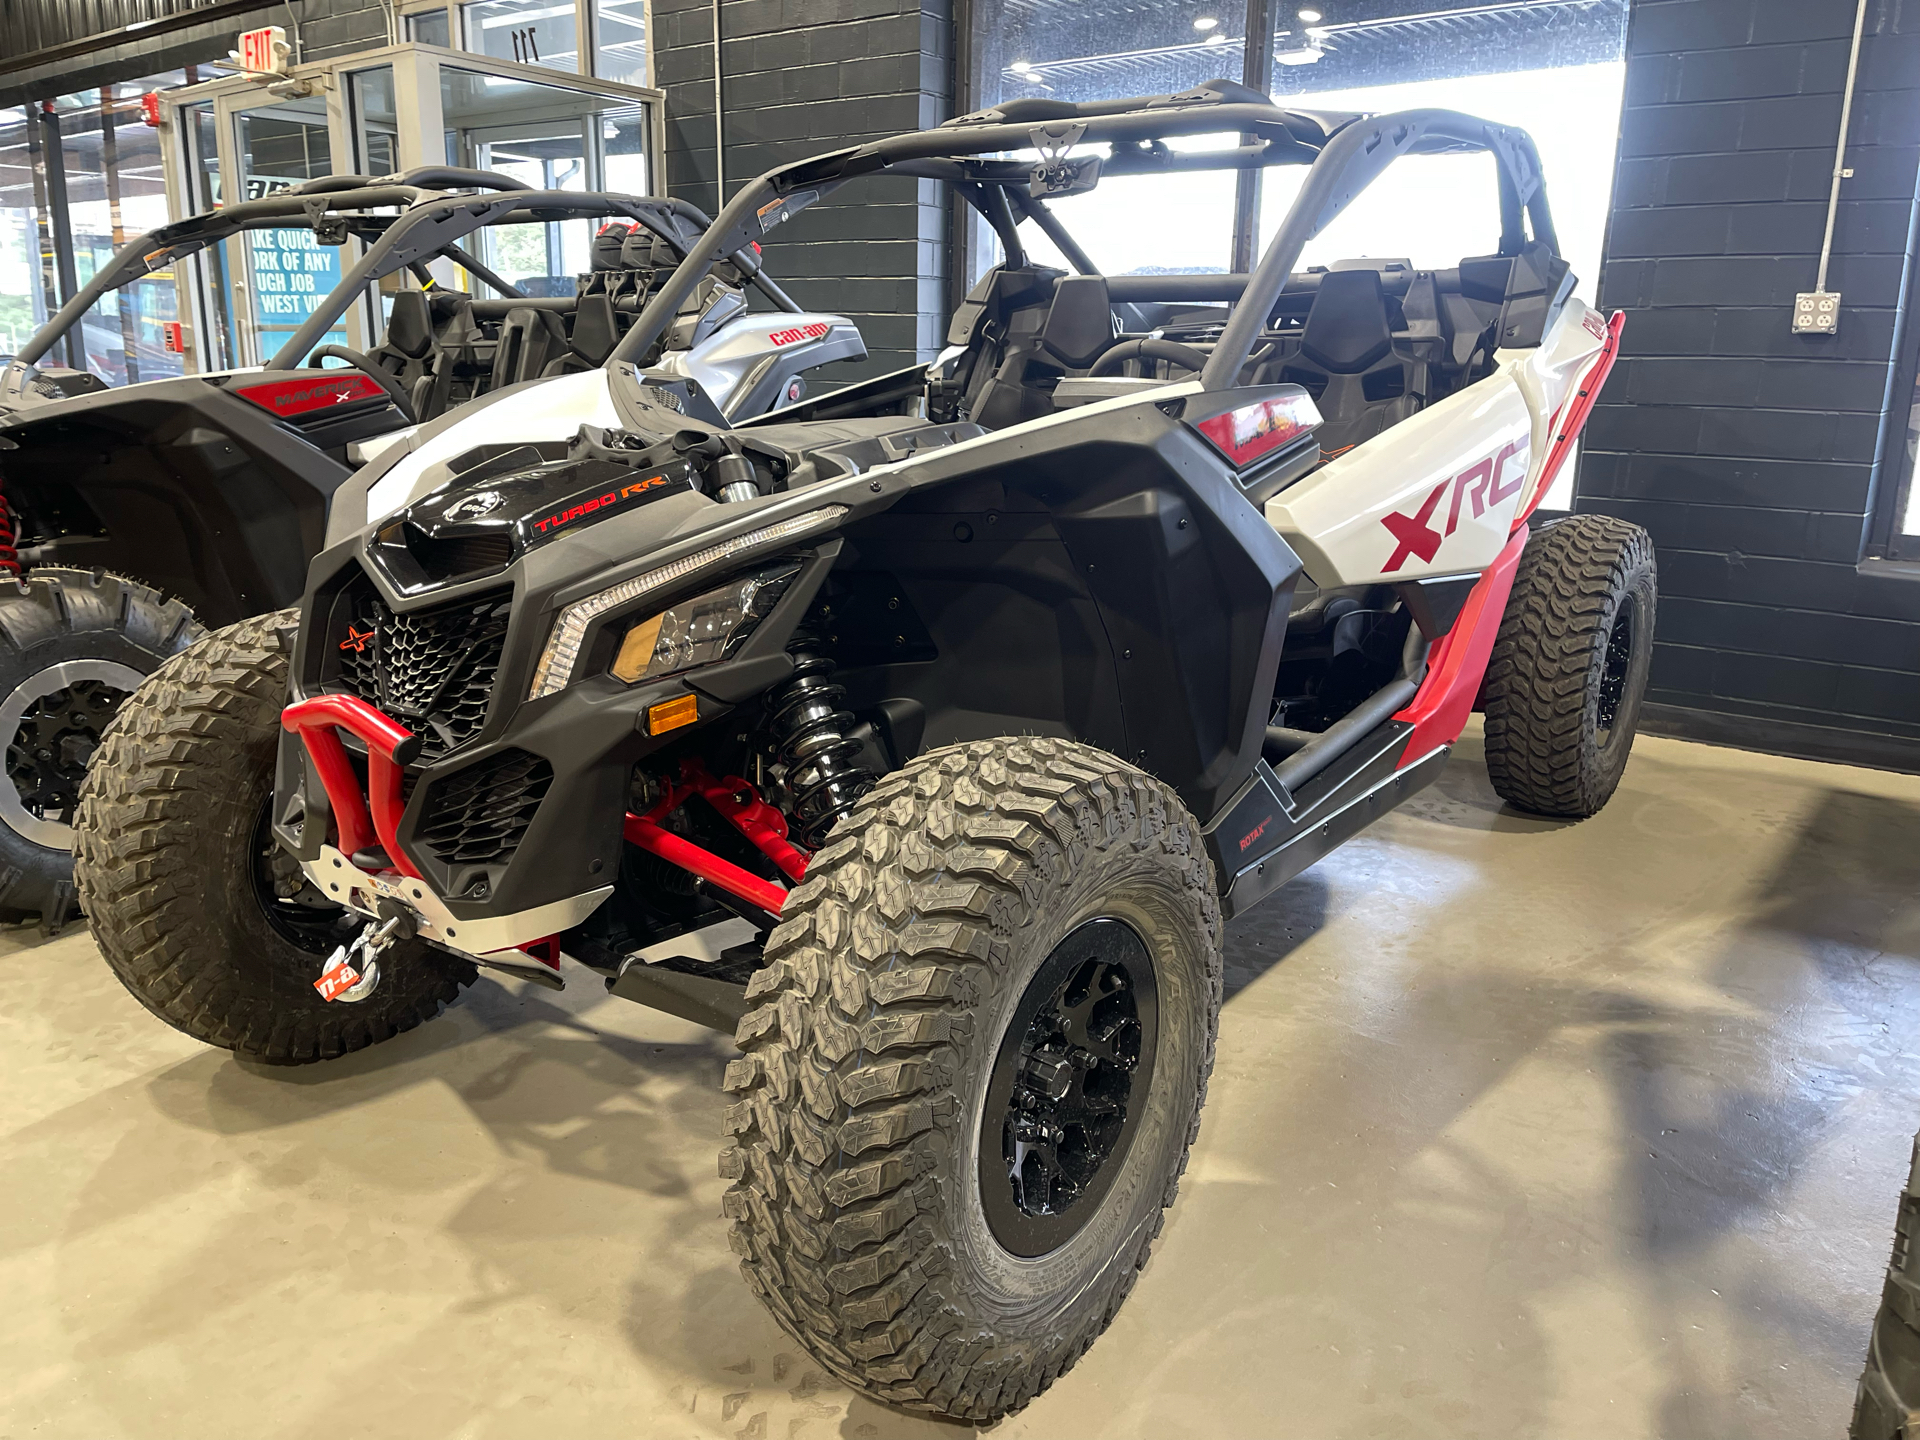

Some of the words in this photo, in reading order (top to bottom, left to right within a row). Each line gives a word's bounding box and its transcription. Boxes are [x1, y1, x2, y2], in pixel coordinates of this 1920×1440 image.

[244, 30, 271, 73] EXIT
[282, 252, 300, 270] OF
[304, 253, 331, 271] ANY
[290, 274, 315, 292] JOB
[261, 294, 300, 313] WEST
[769, 323, 828, 346] can-am
[275, 377, 363, 407] MAVERICK
[534, 492, 617, 532] TURBO
[621, 476, 667, 498] RR
[1380, 432, 1529, 573] XRC
[1240, 825, 1264, 852] ROTAX
